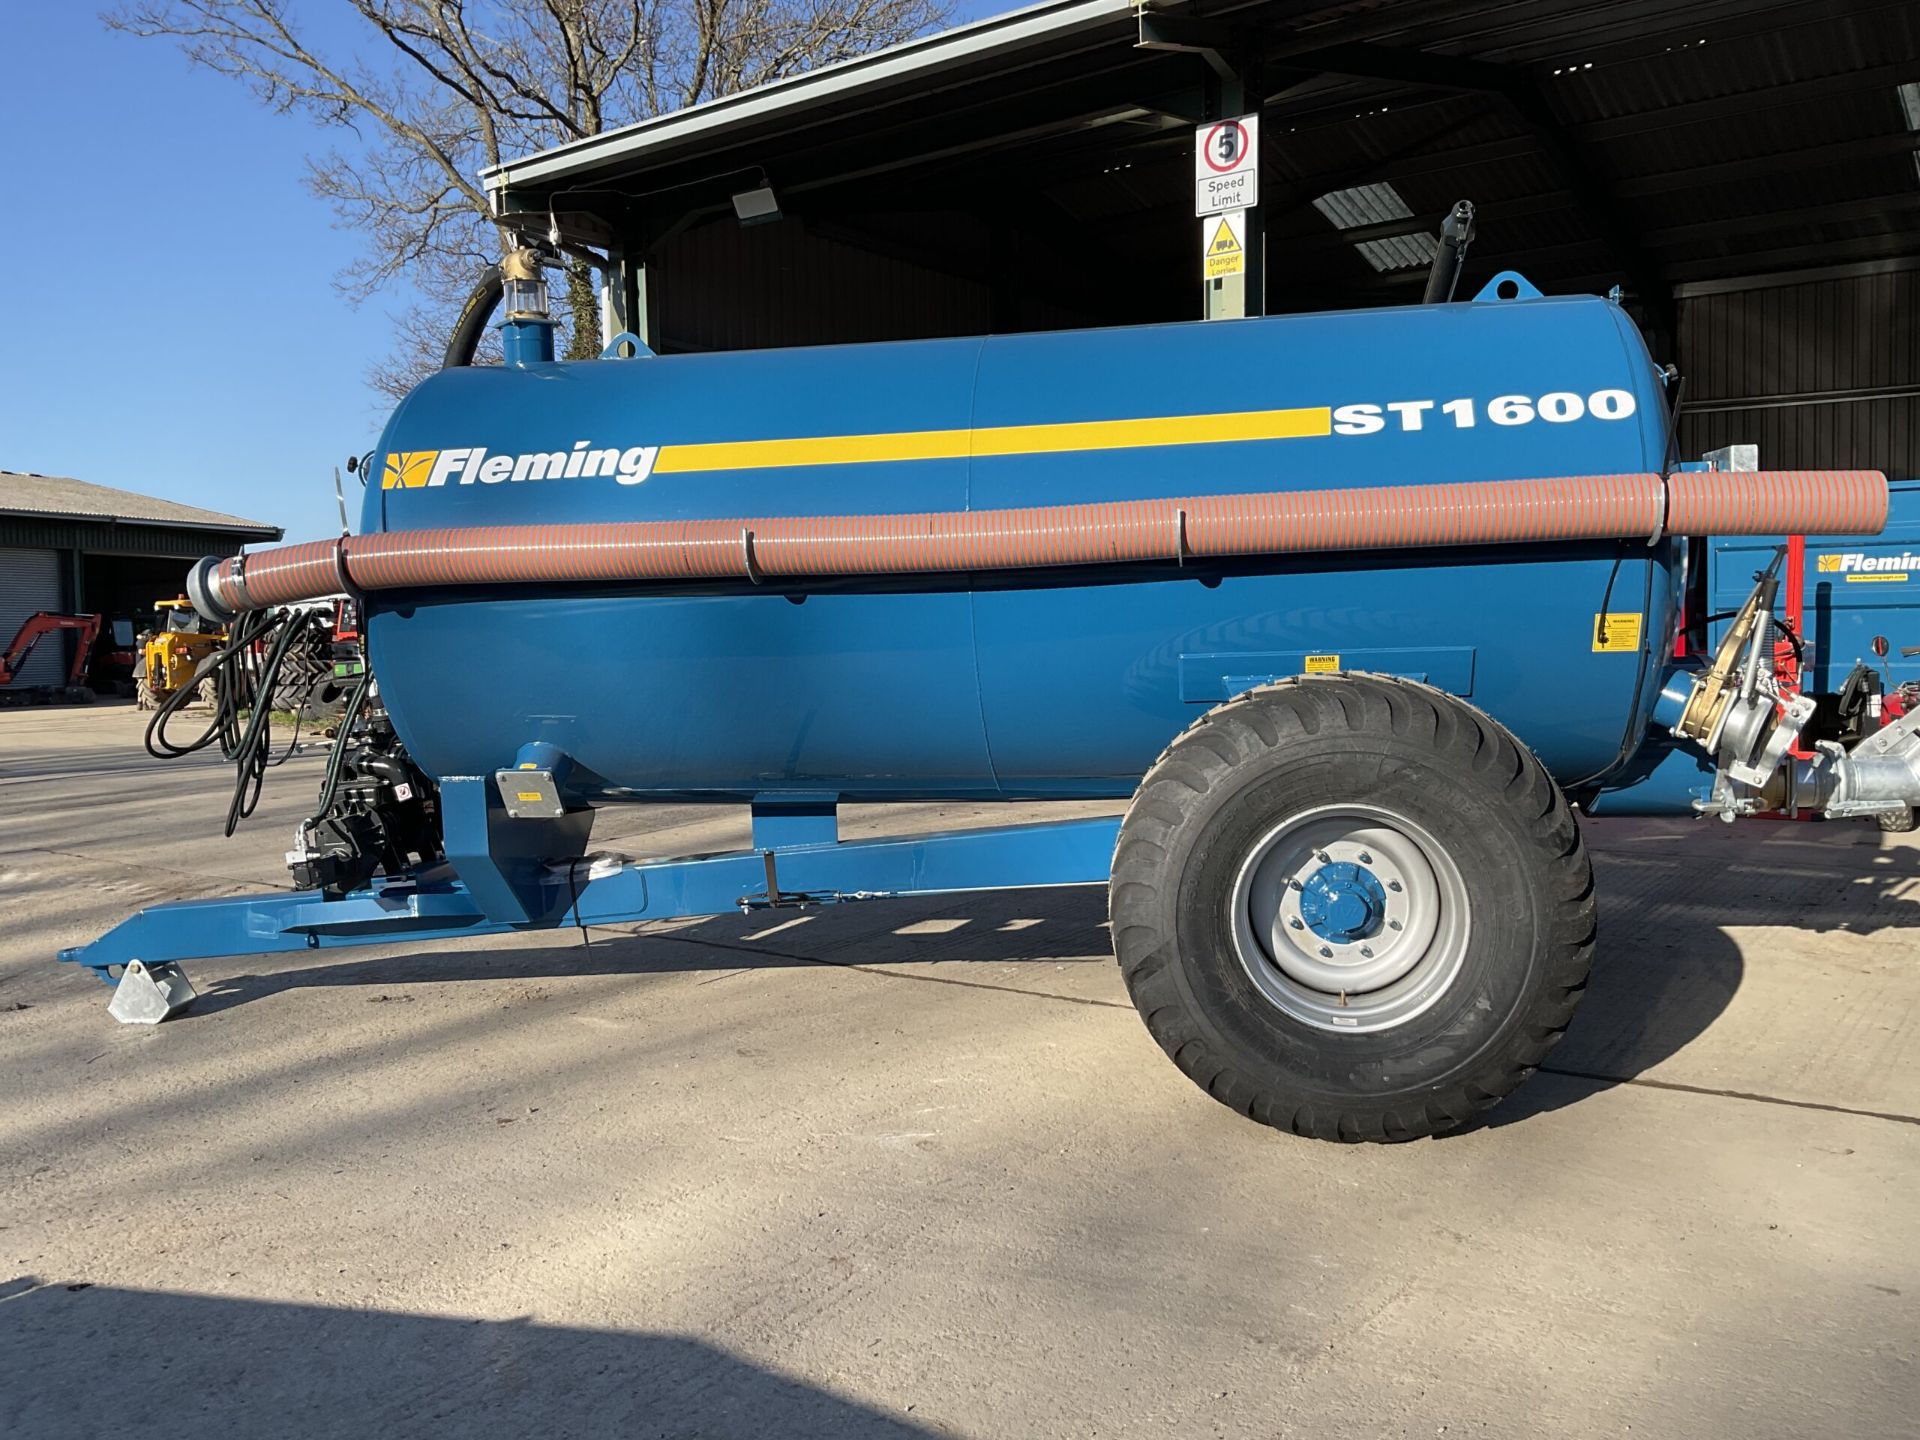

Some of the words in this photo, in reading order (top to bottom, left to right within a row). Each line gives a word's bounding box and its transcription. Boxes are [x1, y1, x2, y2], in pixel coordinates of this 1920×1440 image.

[1218, 133, 1235, 159] 5
[1208, 176, 1244, 192] Speed
[1212, 192, 1241, 206] Limit
[1209, 254, 1240, 267] Danger
[1333, 388, 1637, 436] ST1600
[427, 440, 659, 486] Fleming
